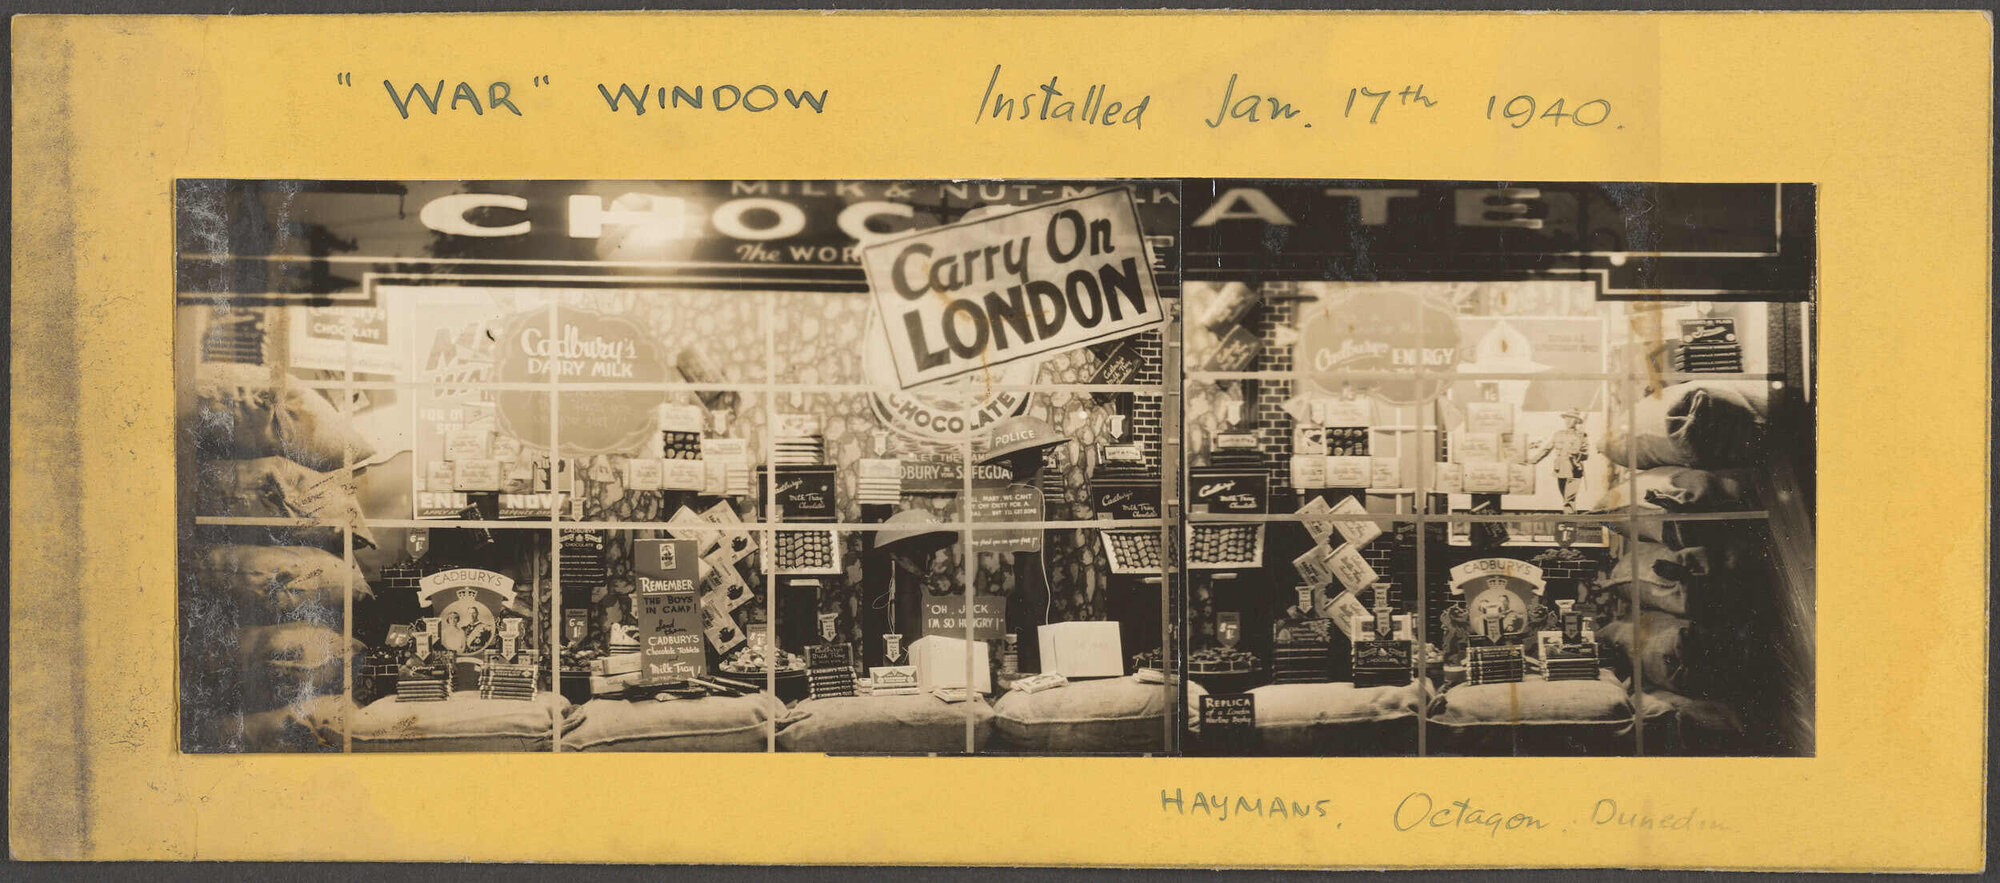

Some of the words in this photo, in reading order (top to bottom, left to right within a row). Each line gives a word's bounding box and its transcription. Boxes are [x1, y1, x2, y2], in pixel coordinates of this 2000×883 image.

[598, 82, 829, 115] WINDOW
[974, 63, 1146, 128] Installed
[1205, 73, 1312, 128] Jan.
[1343, 84, 1437, 124] 17th
[735, 242, 781, 262] The
[789, 245, 861, 262] WOR
[891, 234, 1032, 302] Carry
[1045, 208, 1116, 264] On
[903, 257, 1148, 372] LONDON
[1392, 348, 1455, 366] ENRGY
[591, 361, 634, 377] MILK
[888, 391, 1016, 434] CHOCOLATE
[994, 429, 1036, 447] POLICE
[900, 465, 940, 480] DBURY
[956, 465, 1013, 480] SFEGUA
[639, 577, 695, 592] REMEMBER
[644, 597, 661, 605] THE
[668, 596, 693, 605] BOYS
[943, 618, 955, 629] SO
[648, 635, 700, 646] CADBURY'S
[649, 662, 674, 674] Milk
[1205, 698, 1251, 708] REPLICA
